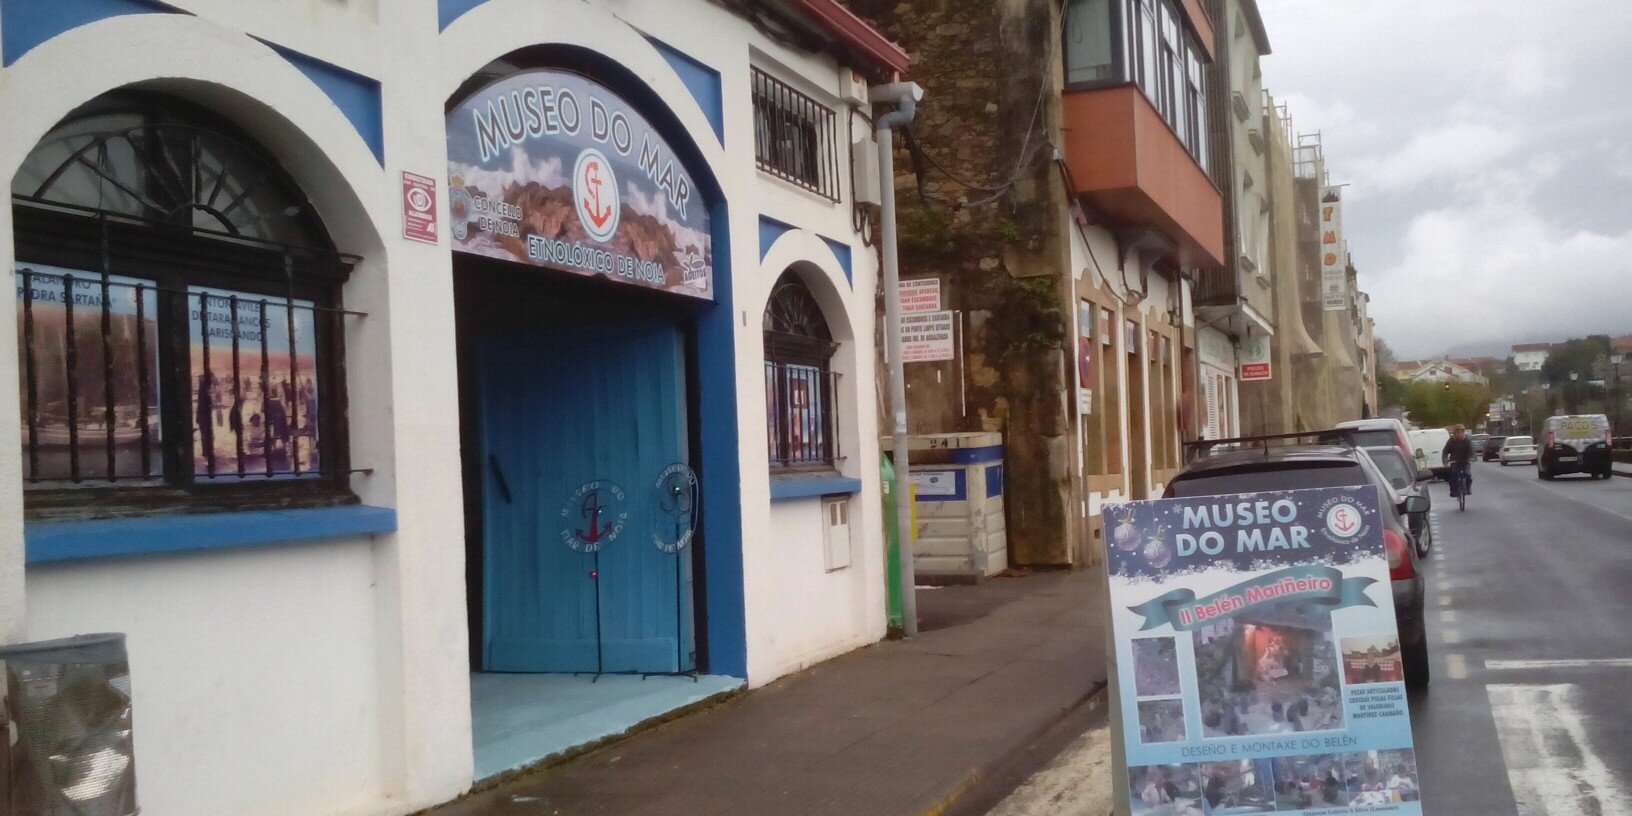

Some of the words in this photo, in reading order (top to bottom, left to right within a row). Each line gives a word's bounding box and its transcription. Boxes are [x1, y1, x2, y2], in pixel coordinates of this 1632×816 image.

[474, 87, 580, 161] MUSEO
[590, 97, 632, 155] DO
[639, 133, 689, 219] MAR
[474, 196, 522, 220] CONCELLO
[481, 216, 494, 231] DE
[495, 220, 519, 237] NOIA
[528, 234, 613, 272] ETNOLÓXICO
[618, 257, 635, 277] DE
[635, 259, 665, 284] NOIA
[17, 286, 56, 302] PDRA
[208, 311, 271, 328] TARAANCS
[1182, 499, 1298, 529] MUSEO
[1317, 497, 1338, 518] MUSEO
[585, 543, 601, 552] DE
[1176, 531, 1225, 557] DO
[1237, 525, 1311, 553] MAR
[1195, 590, 1244, 622] Belén
[1246, 574, 1333, 601] Mariñeiro
[1182, 743, 1226, 757] DESEÑO
[1231, 744, 1238, 754] E
[1242, 740, 1297, 752] MONTAXE
[1302, 738, 1320, 748] DO
[1324, 735, 1357, 747] BELÉN
